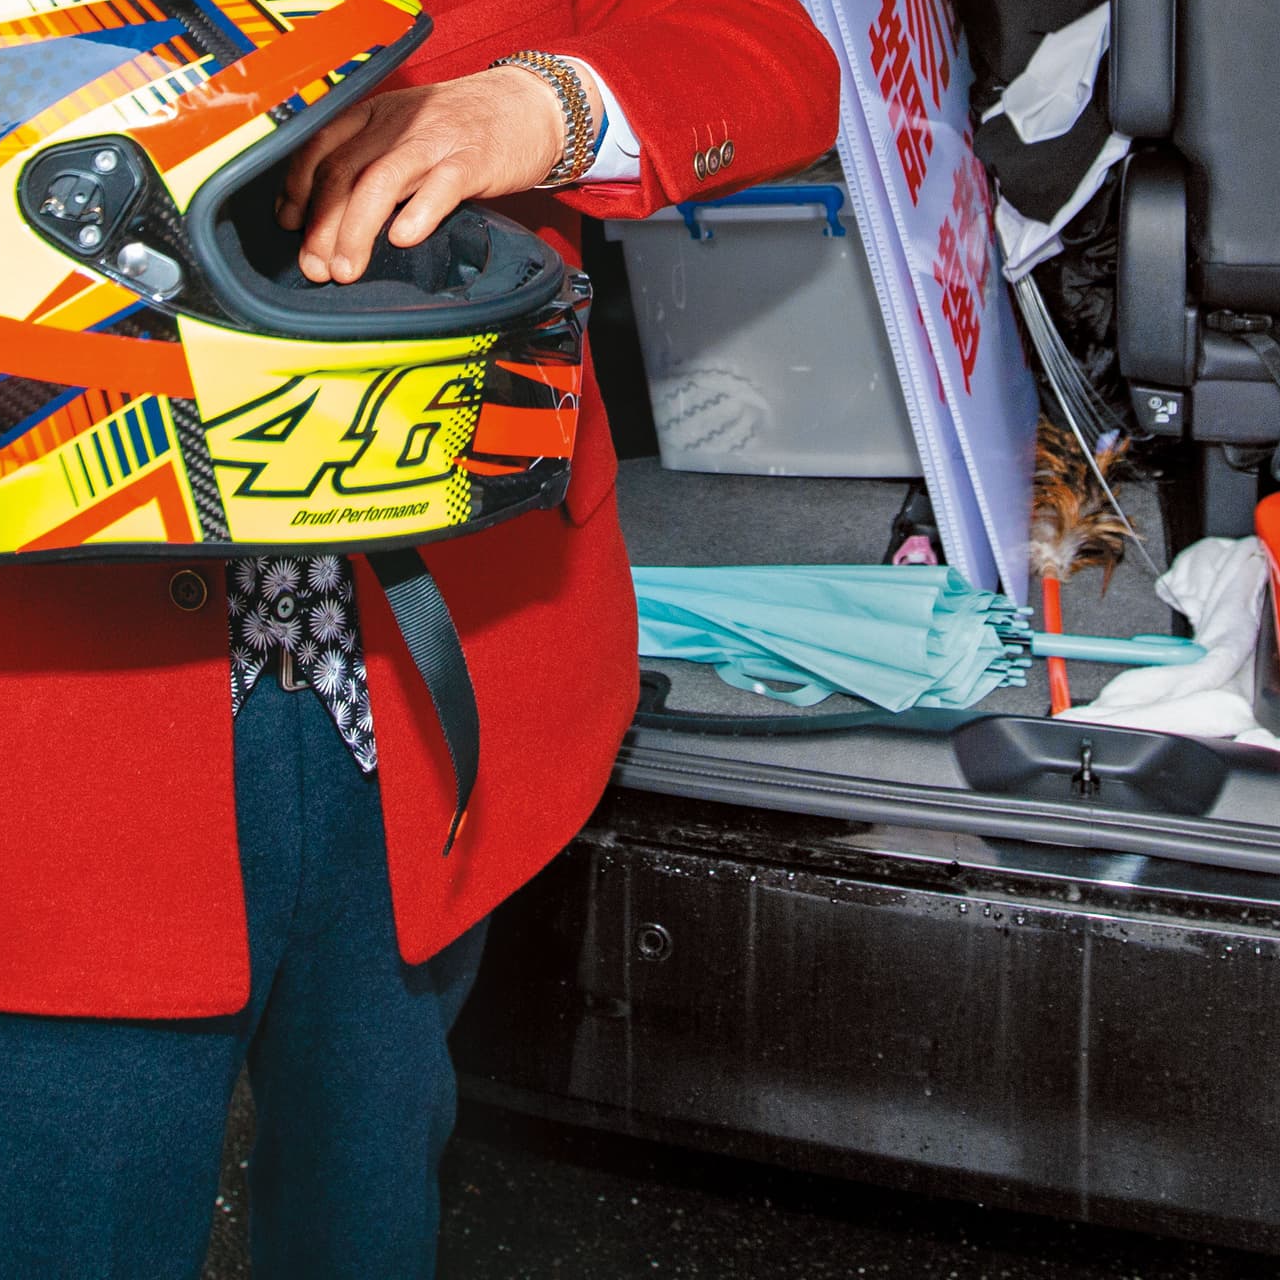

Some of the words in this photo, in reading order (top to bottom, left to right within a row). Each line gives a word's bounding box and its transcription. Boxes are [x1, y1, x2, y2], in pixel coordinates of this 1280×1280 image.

[203, 363, 472, 498] 46
[289, 509, 337, 527] Drudi
[337, 500, 430, 525] Performance
